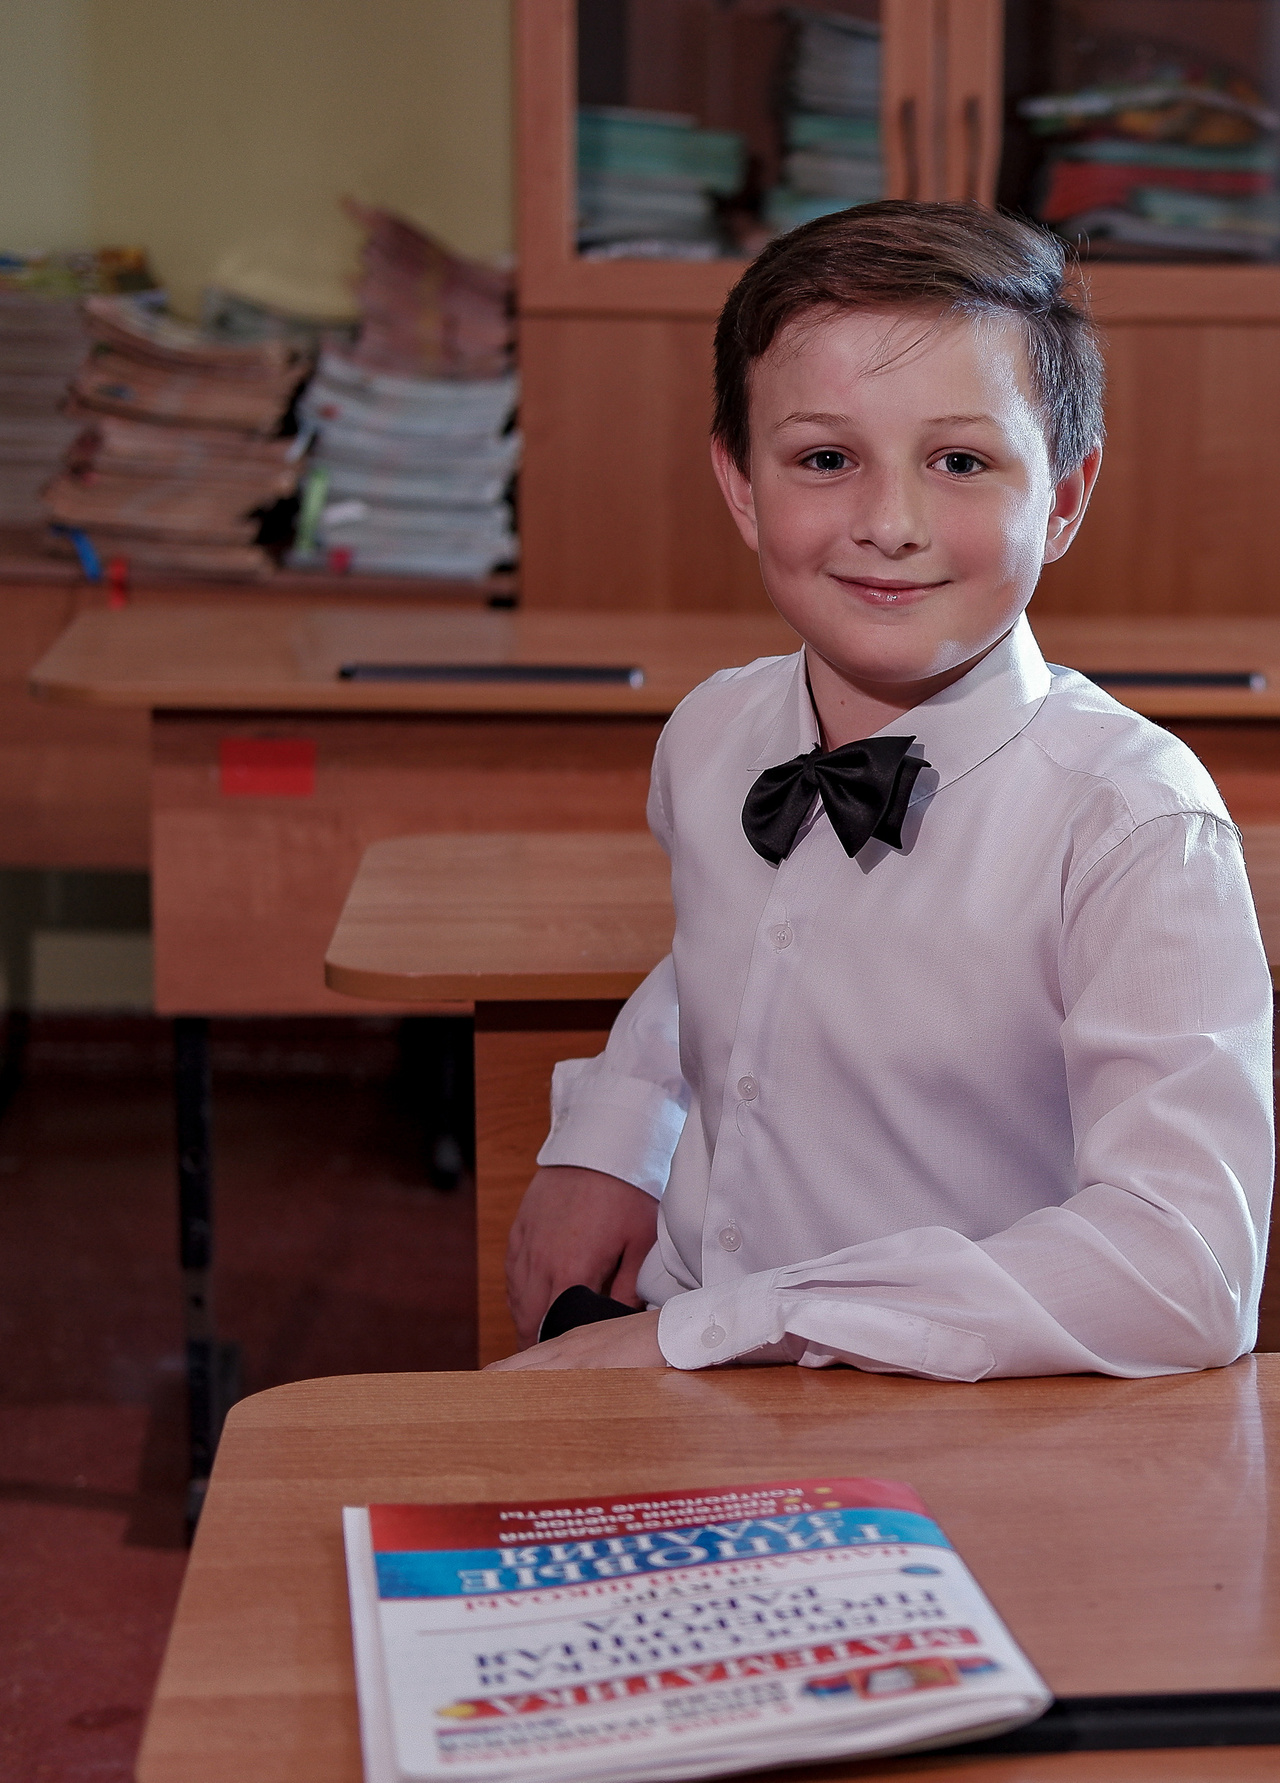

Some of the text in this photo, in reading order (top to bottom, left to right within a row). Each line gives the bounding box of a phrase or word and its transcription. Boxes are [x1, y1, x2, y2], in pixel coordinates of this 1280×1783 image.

[500, 1488, 804, 1521] Контрольные ответы
[500, 1502, 815, 1542] 10 вариантов заданий
[534, 1499, 777, 1530] Критерии оценок
[457, 1524, 899, 1593] ТИПОВЫЕ
[500, 1512, 844, 1567] ЗАДАНИЯ
[464, 1579, 634, 1611] ШКОЛЫ
[582, 1584, 817, 1633] РАБОТА
[474, 1589, 937, 1668] ПРОВЕРОЧНАЯ
[488, 1627, 963, 1714] МАТЕМАТИКА
